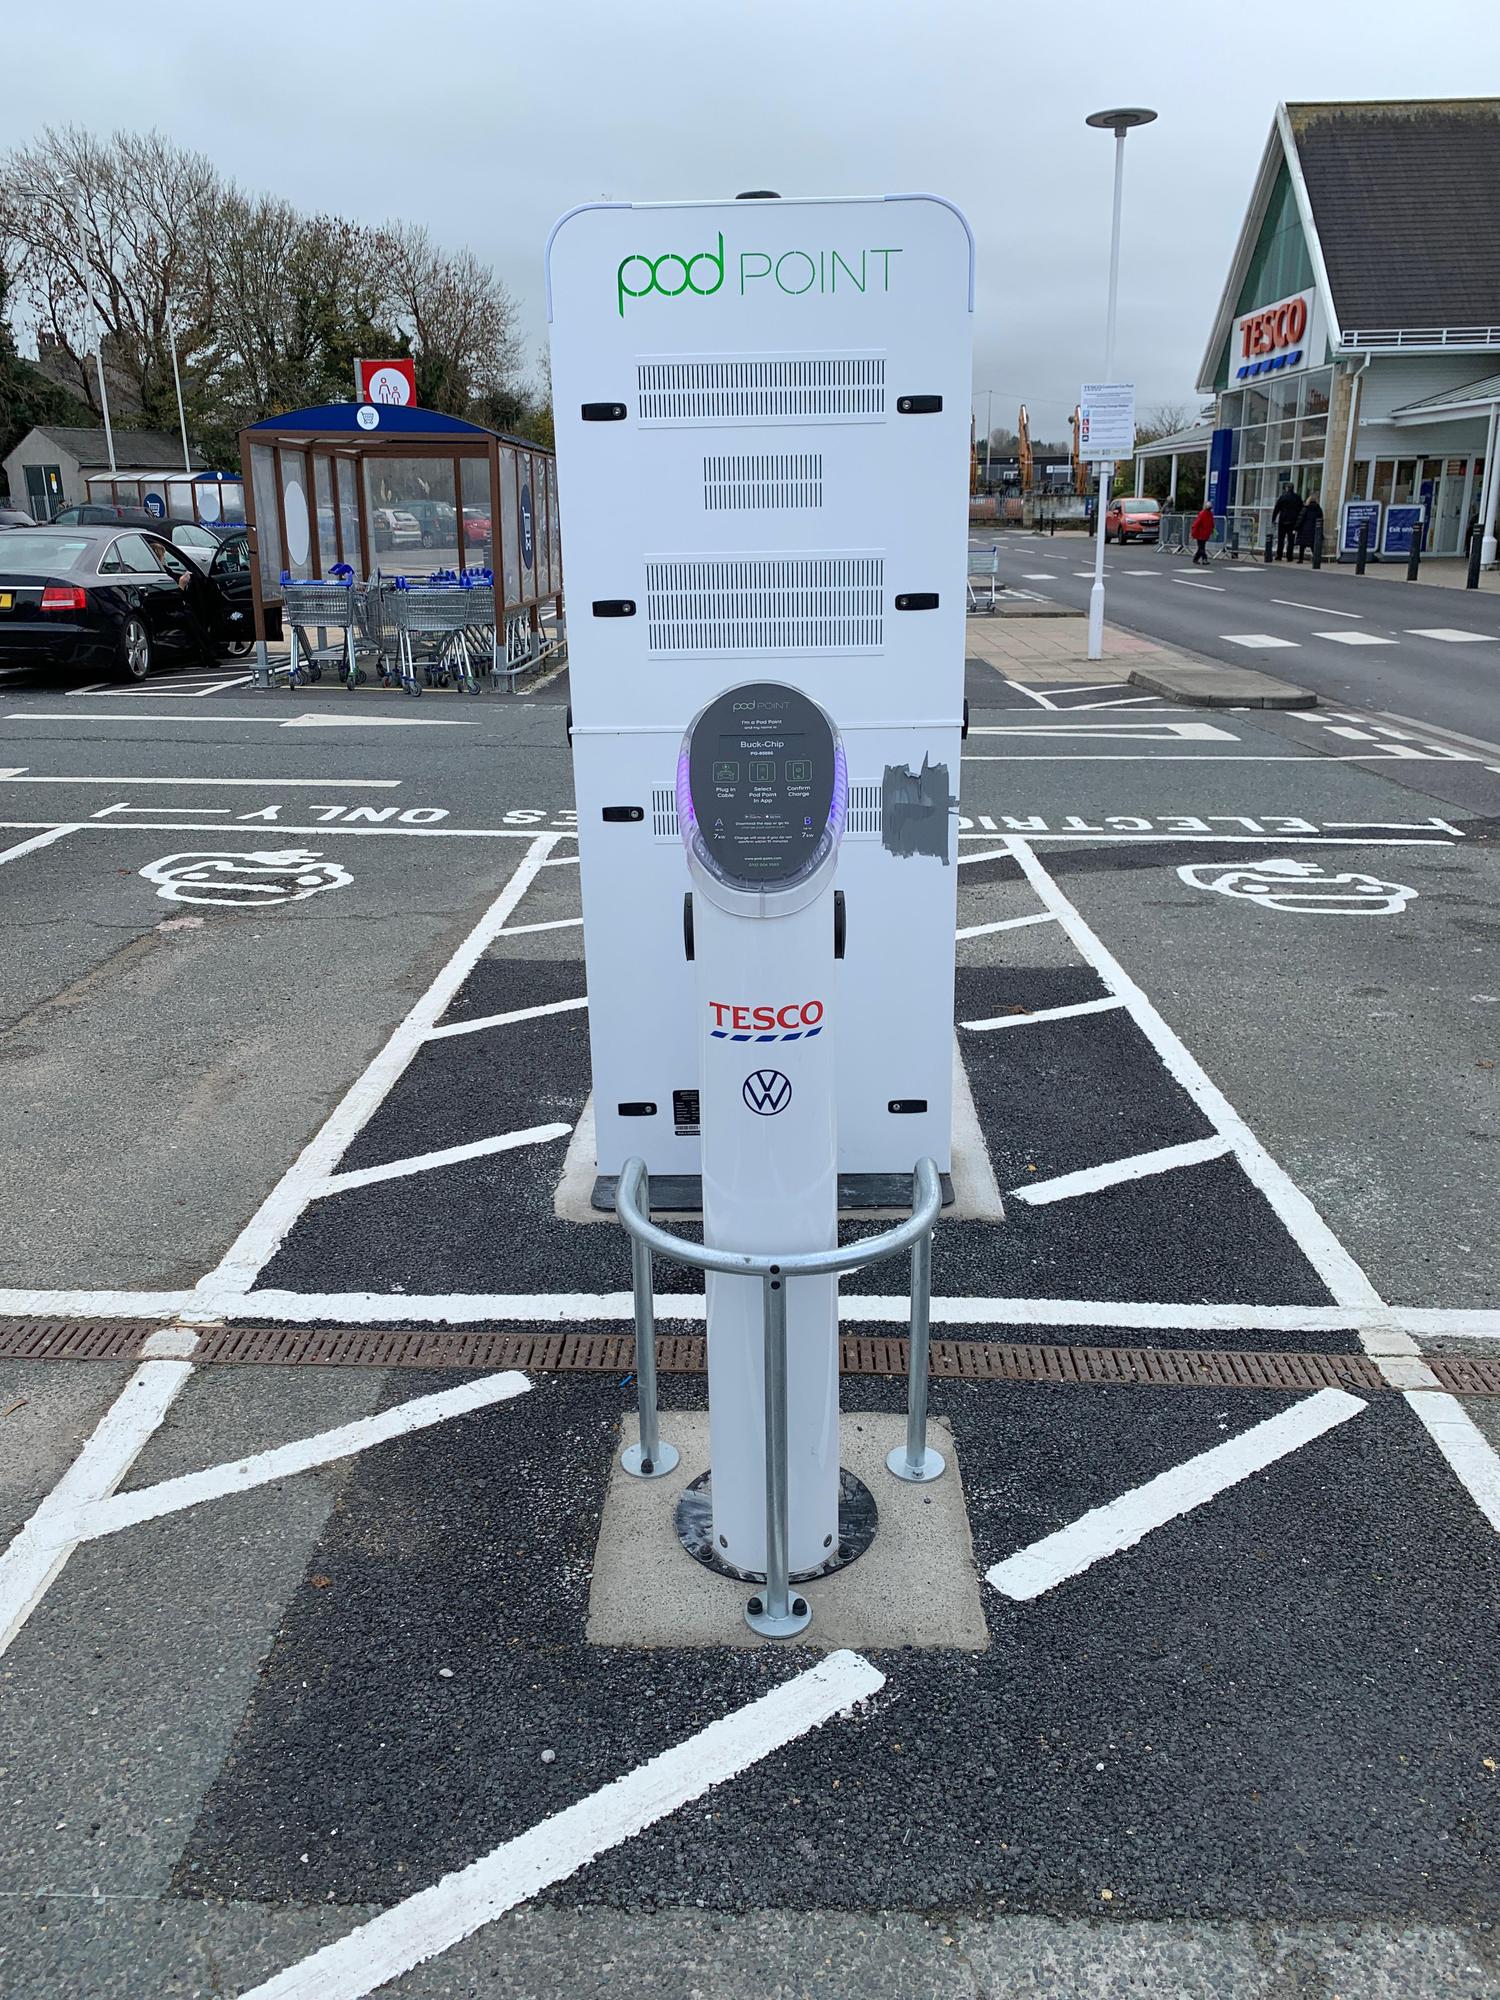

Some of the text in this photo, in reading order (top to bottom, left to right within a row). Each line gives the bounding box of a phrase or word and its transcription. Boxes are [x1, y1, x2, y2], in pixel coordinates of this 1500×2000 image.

[618, 231, 903, 318] pod POINT
[1240, 297, 1307, 358] TESCO
[758, 702, 789, 710] POINT
[740, 740, 785, 748] Buck-Chip
[236, 805, 451, 824] ONLY
[804, 817, 813, 825] B
[714, 818, 724, 826] A
[709, 1000, 824, 1031] TESCO
